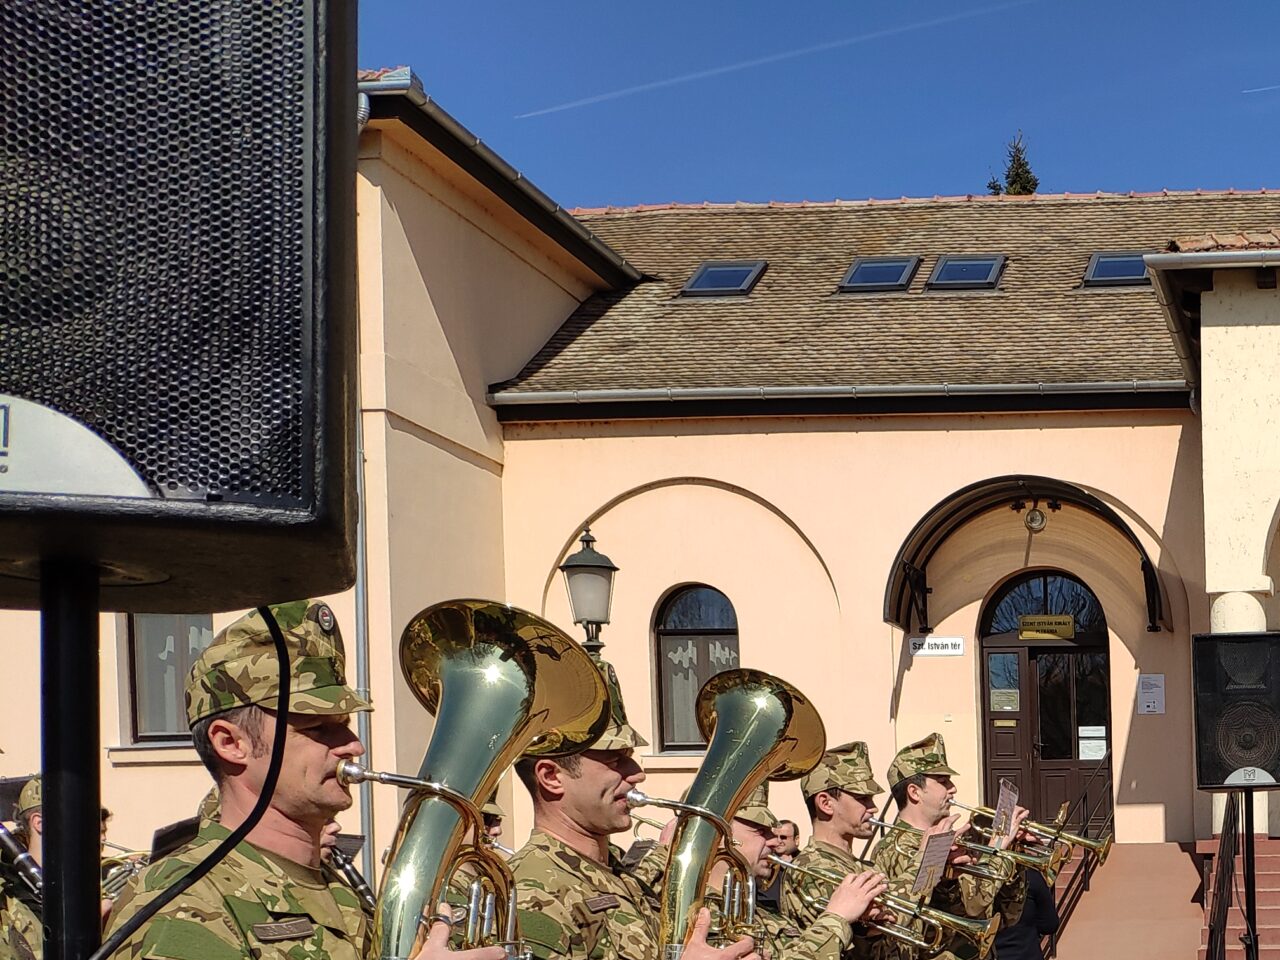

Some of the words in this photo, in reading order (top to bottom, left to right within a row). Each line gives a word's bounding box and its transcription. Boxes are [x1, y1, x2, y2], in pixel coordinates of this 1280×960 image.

[912, 642, 925, 650] Szt.
[927, 641, 949, 650] István
[951, 641, 961, 650] tér
